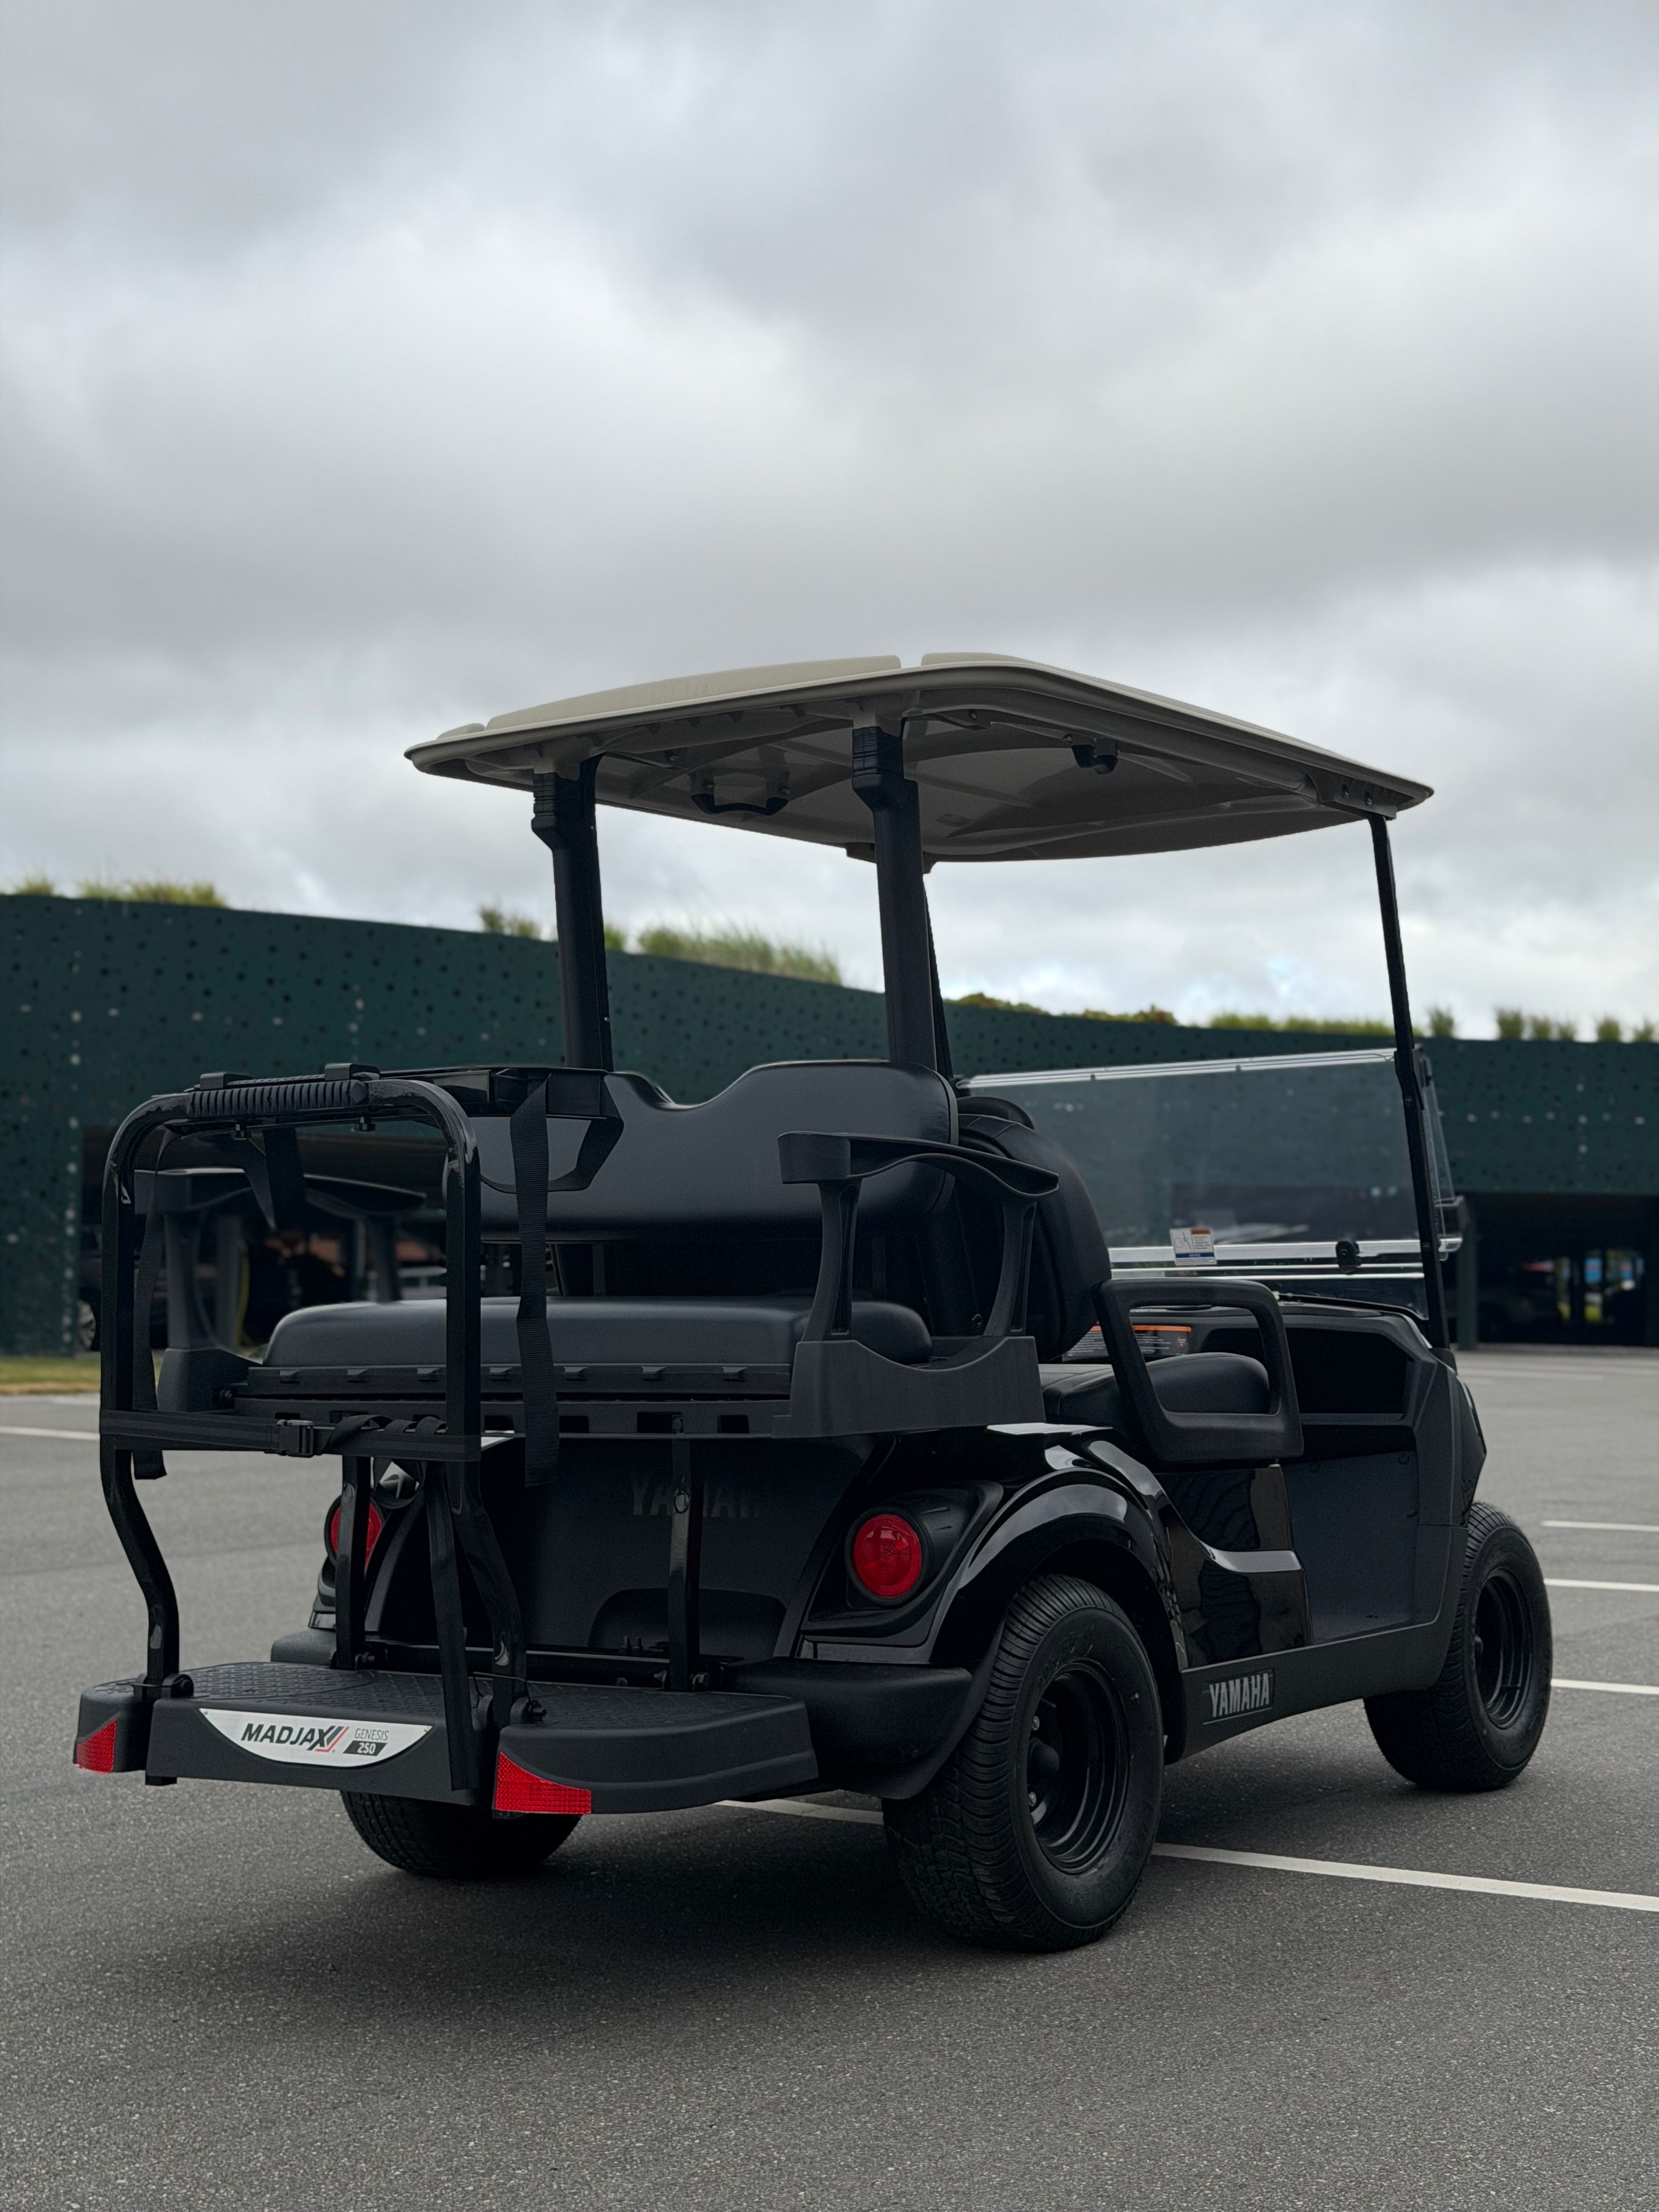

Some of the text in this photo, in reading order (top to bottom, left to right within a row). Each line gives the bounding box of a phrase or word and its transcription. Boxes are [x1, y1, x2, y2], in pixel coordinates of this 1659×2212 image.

[630, 1469, 763, 1519] YAAH
[1209, 1673, 1269, 1718] YAMAHA
[240, 1723, 350, 1752] MADJAX
[354, 1728, 389, 1741] GENESIS
[357, 1742, 376, 1754] 250
